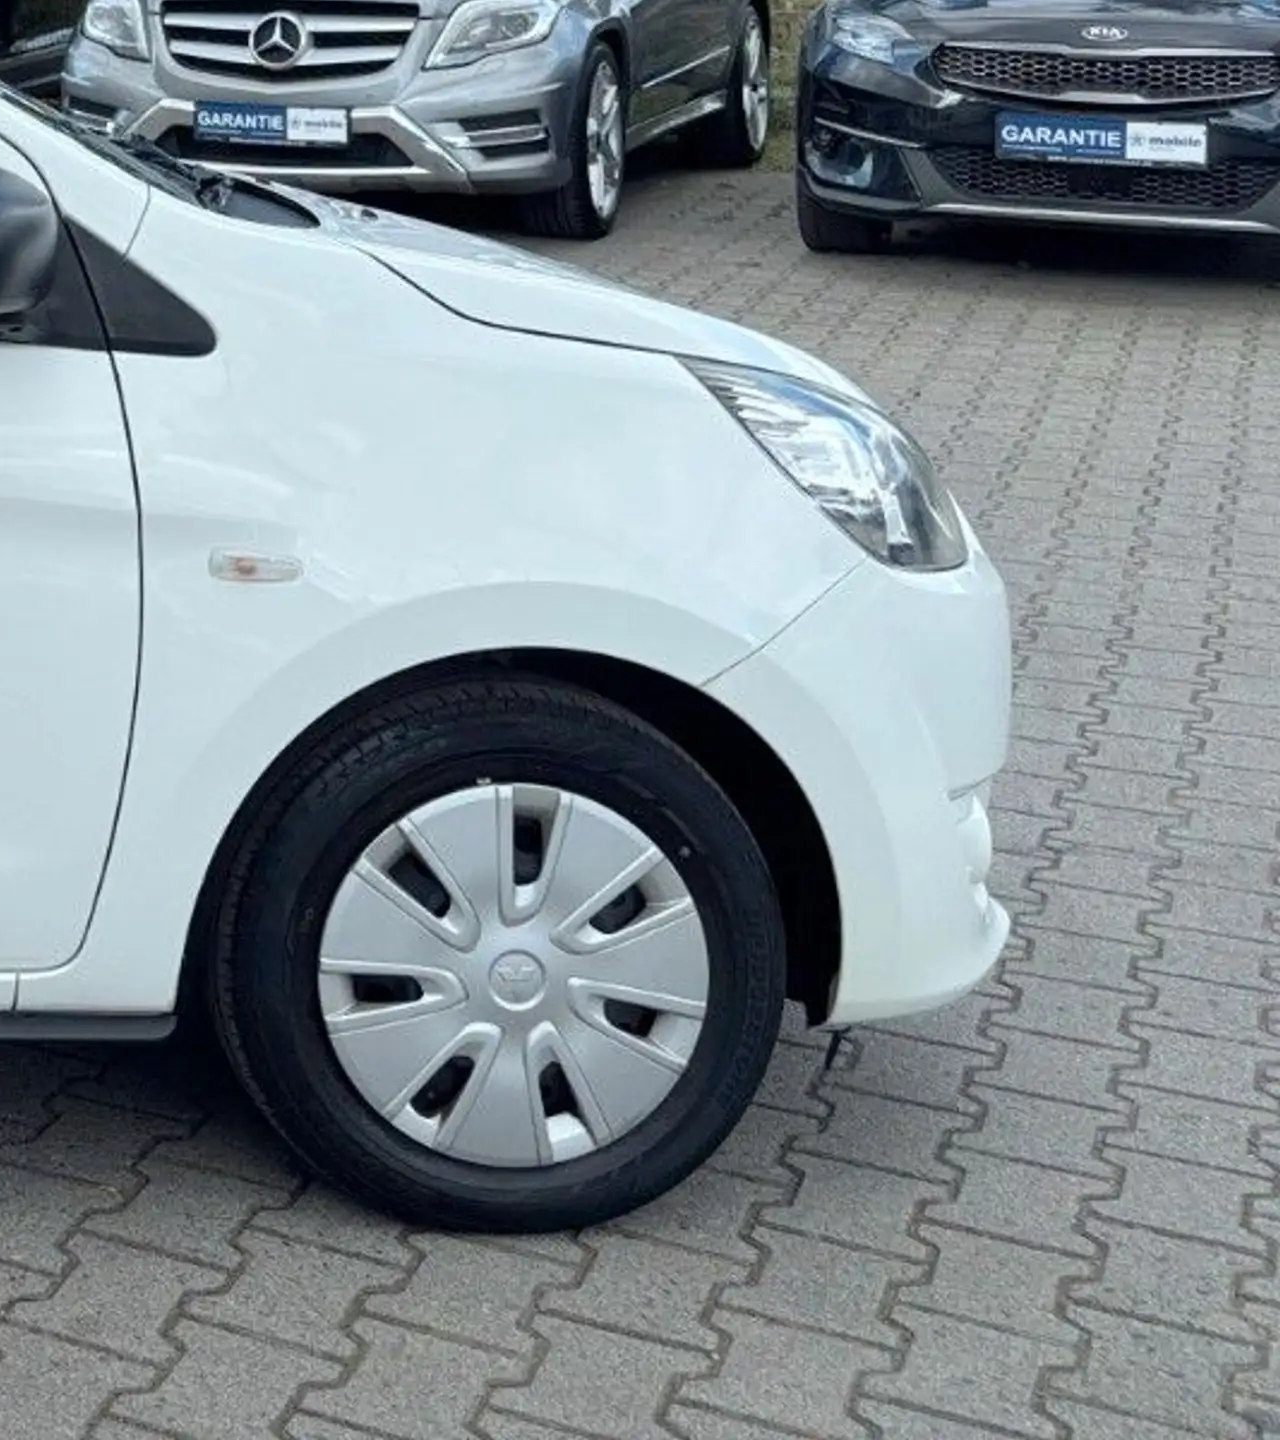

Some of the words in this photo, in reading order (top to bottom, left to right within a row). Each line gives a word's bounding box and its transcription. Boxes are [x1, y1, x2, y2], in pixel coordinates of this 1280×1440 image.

[1088, 26, 1122, 38] KIA
[197, 111, 284, 131] GARANTIE
[1000, 124, 1122, 149] GARANTIE
